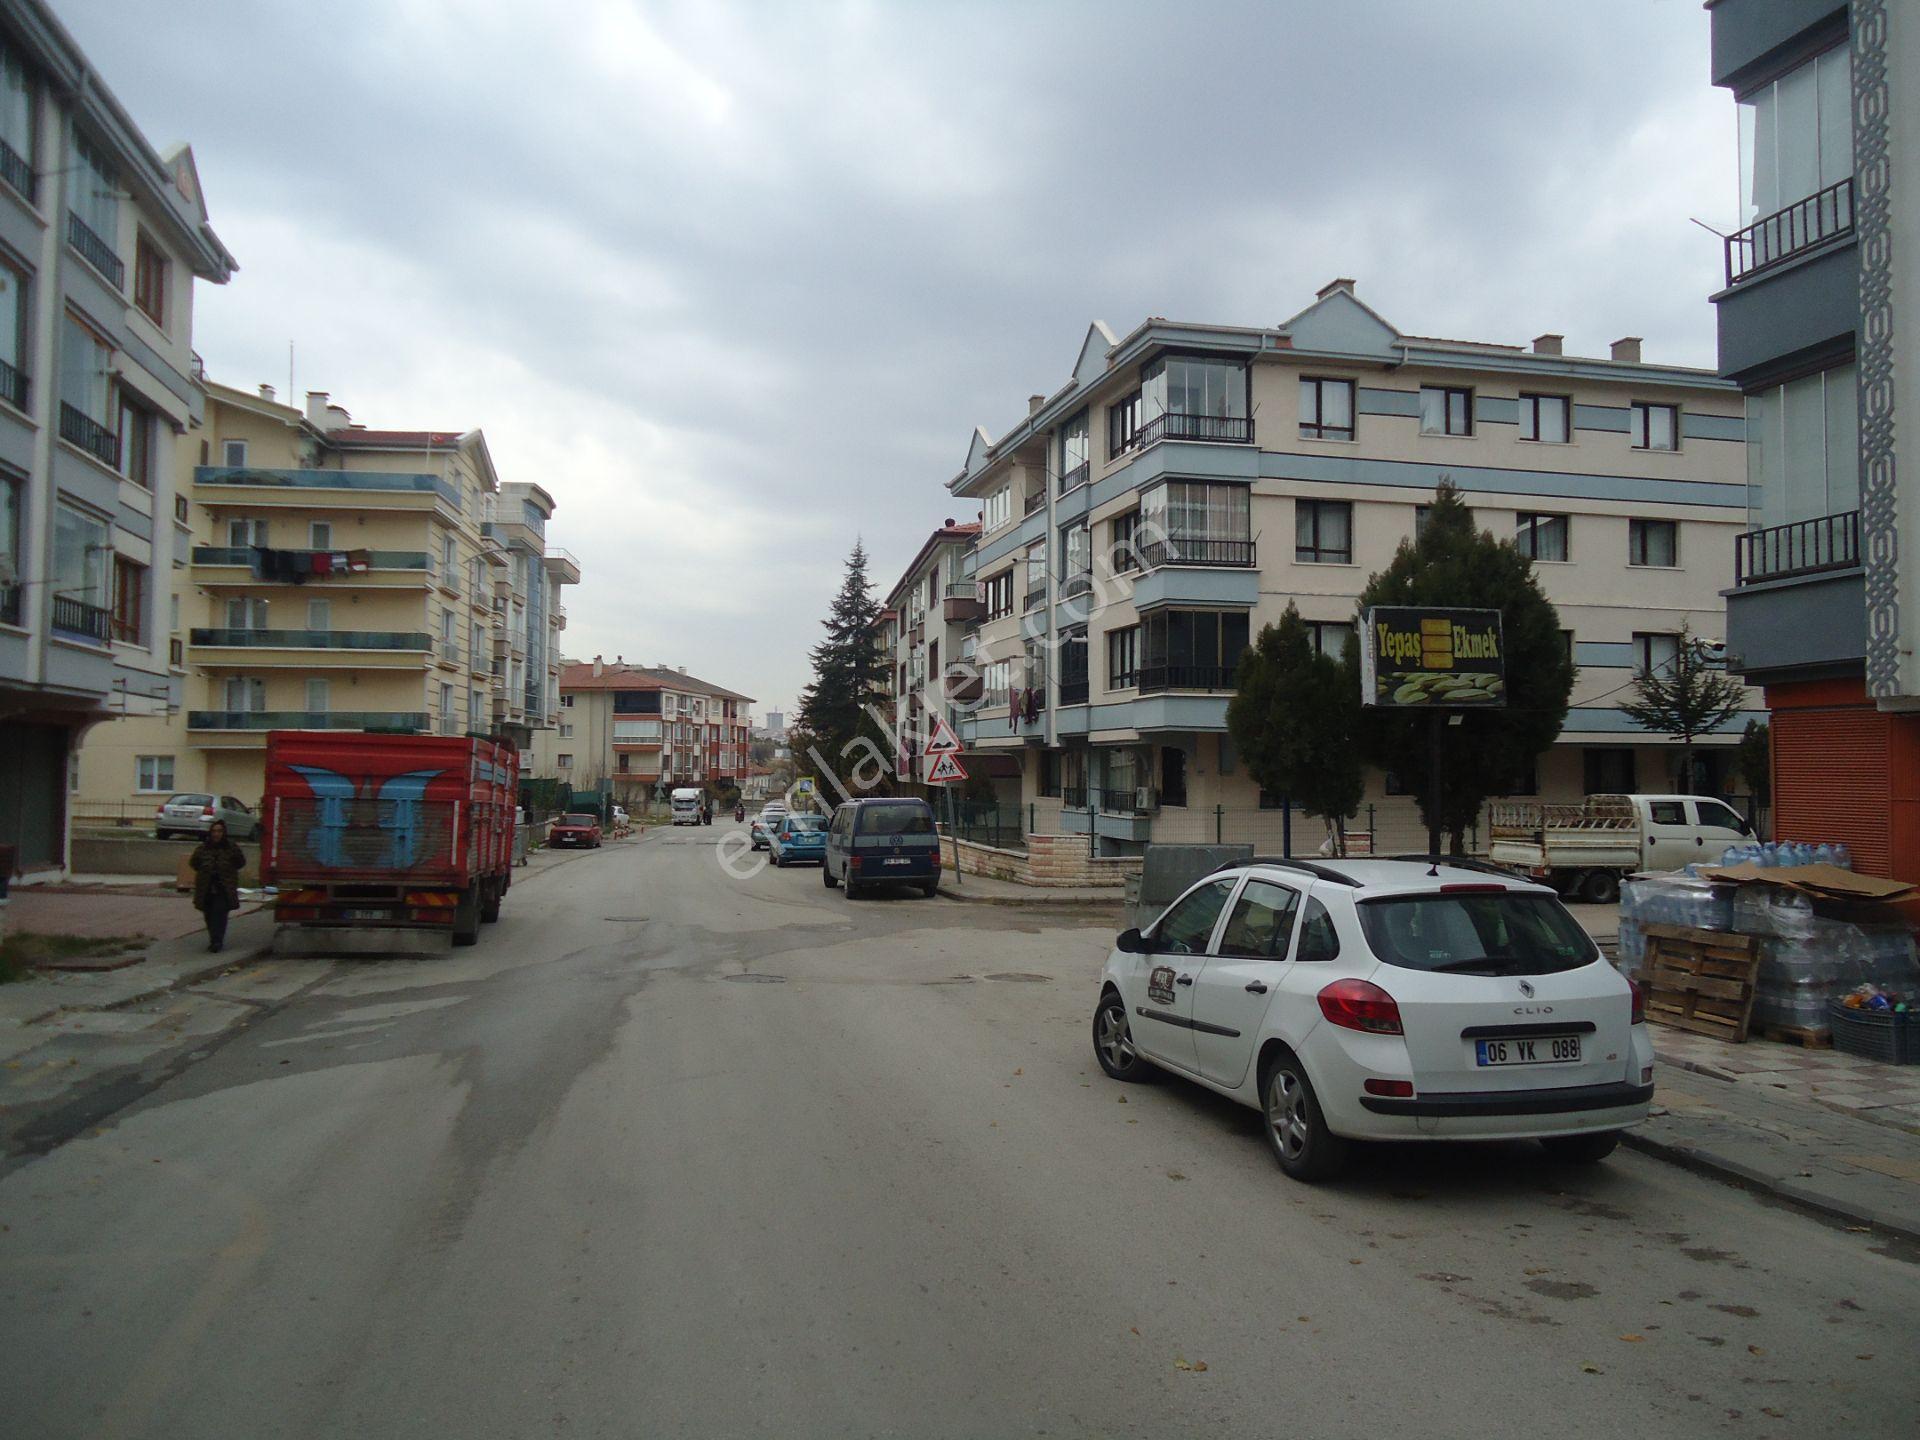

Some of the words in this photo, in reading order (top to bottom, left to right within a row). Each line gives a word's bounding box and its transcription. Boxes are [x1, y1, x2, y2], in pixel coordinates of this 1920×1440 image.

[1377, 623, 1421, 666] Yepaş
[1453, 625, 1498, 658] Ekmek
[1513, 1006, 1554, 1015] CLIO
[1488, 1042, 1508, 1063] 06
[1517, 1041, 1537, 1061] VK
[1552, 1038, 1579, 1060] 088
